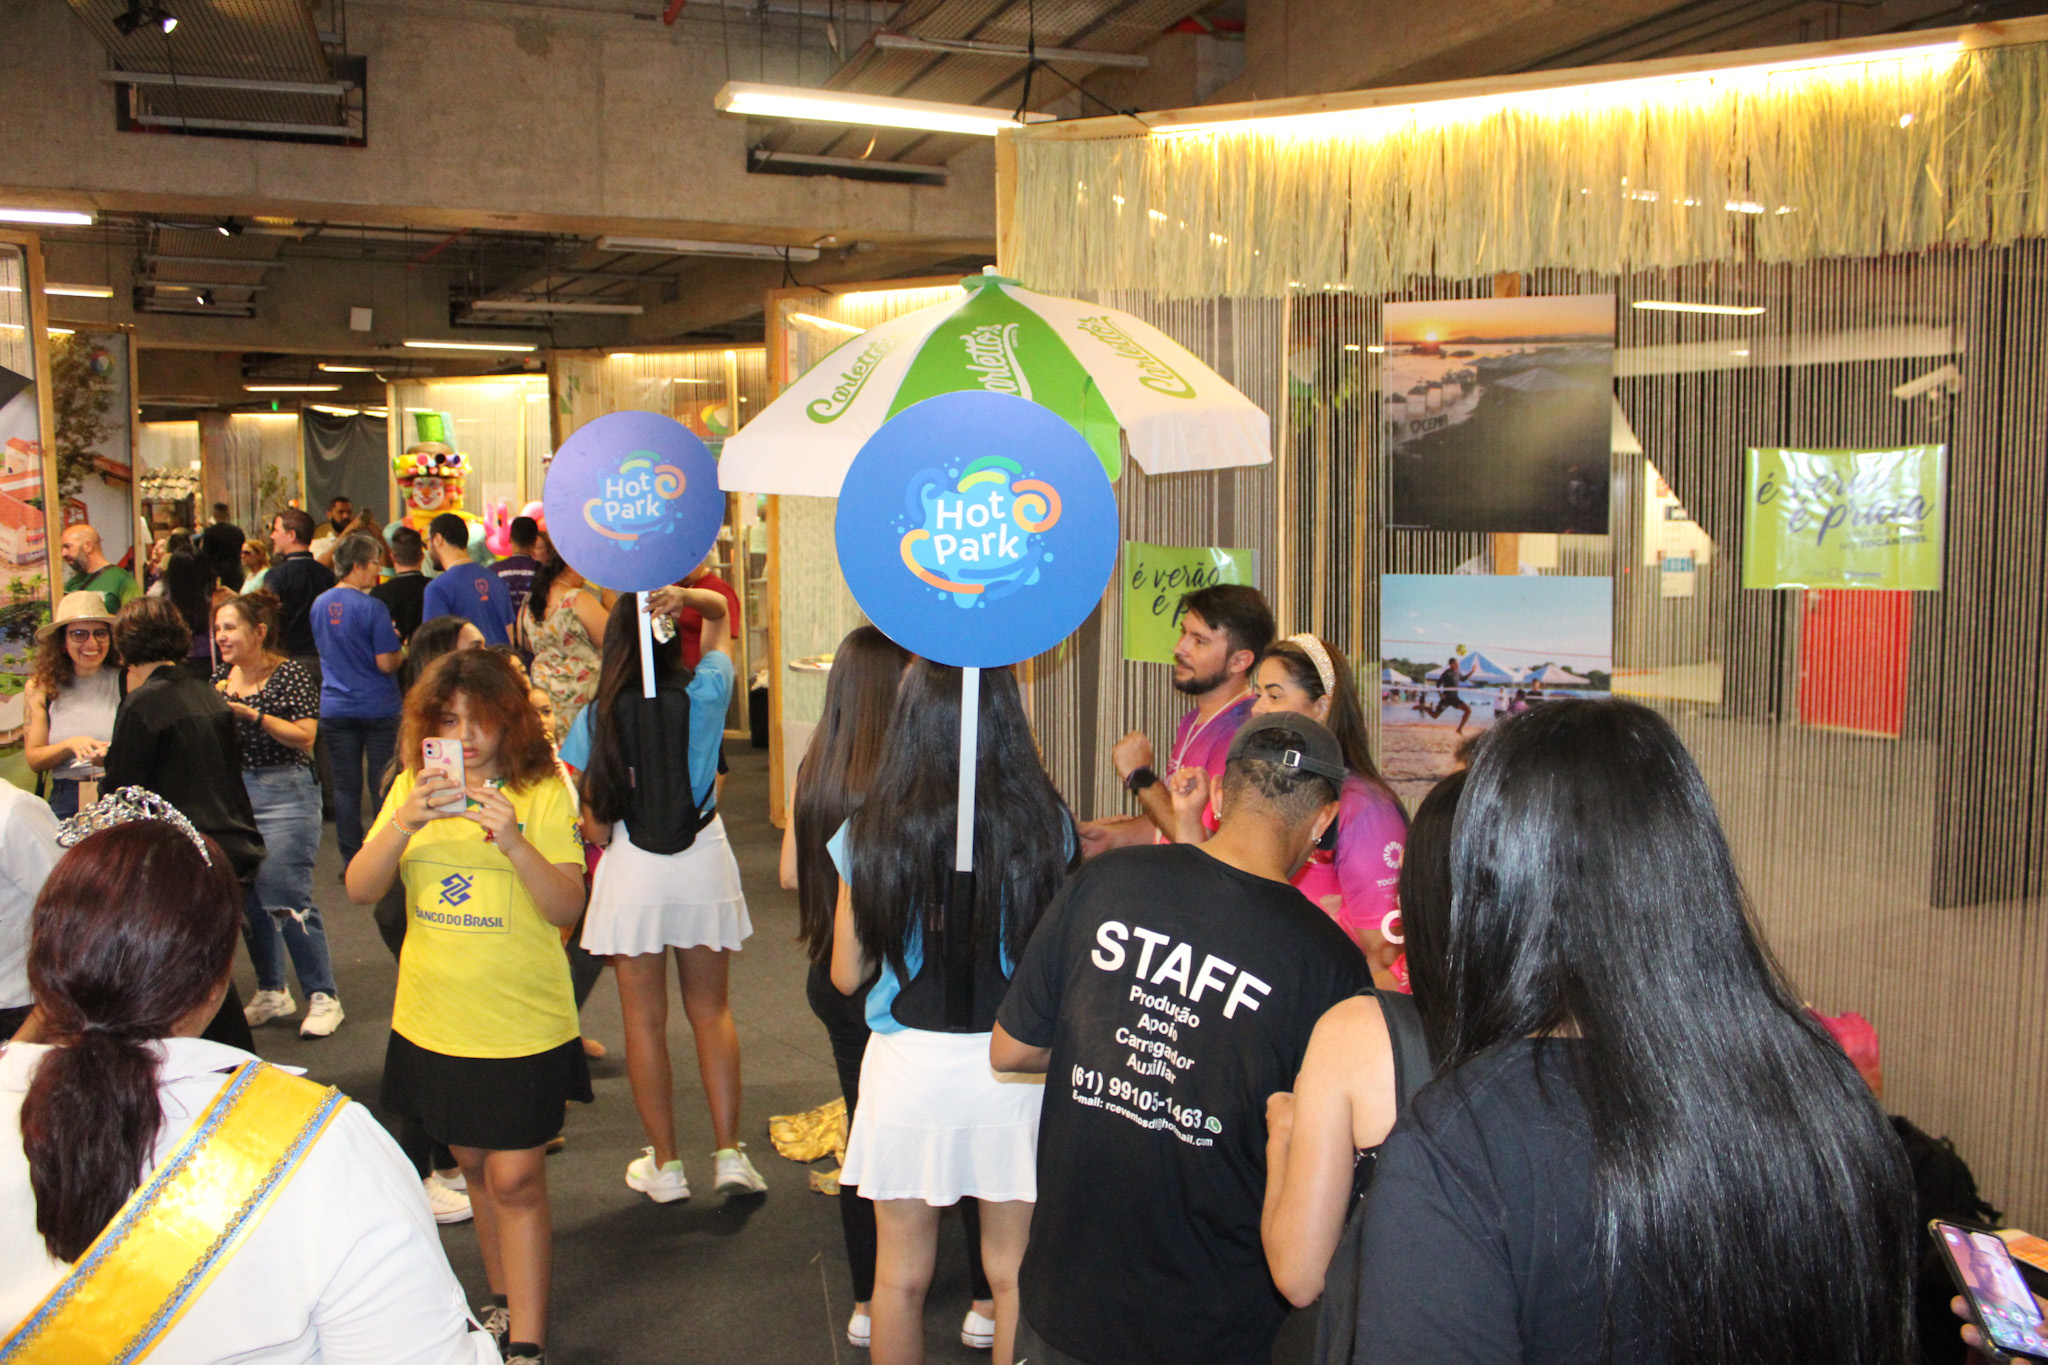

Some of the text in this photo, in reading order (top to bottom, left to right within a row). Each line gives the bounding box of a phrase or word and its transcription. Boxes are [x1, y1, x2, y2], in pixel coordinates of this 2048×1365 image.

[959, 323, 1033, 402] arletto's
[606, 472, 651, 499] Hot
[604, 494, 660, 522] Park
[936, 491, 1006, 530] Hot
[934, 523, 1019, 565] Park
[1132, 562, 1220, 590] é verão
[1152, 587, 1170, 616] é
[415, 905, 505, 928] BANCO DO BRASIL
[1091, 920, 1272, 1020] STAFF
[1129, 985, 1200, 1028] Produção
[1137, 1013, 1178, 1042] Apoio
[1115, 1027, 1195, 1070] Carregador
[1126, 1053, 1176, 1084] Auxiliar
[1072, 1064, 1203, 1129] (61) 99105-1463
